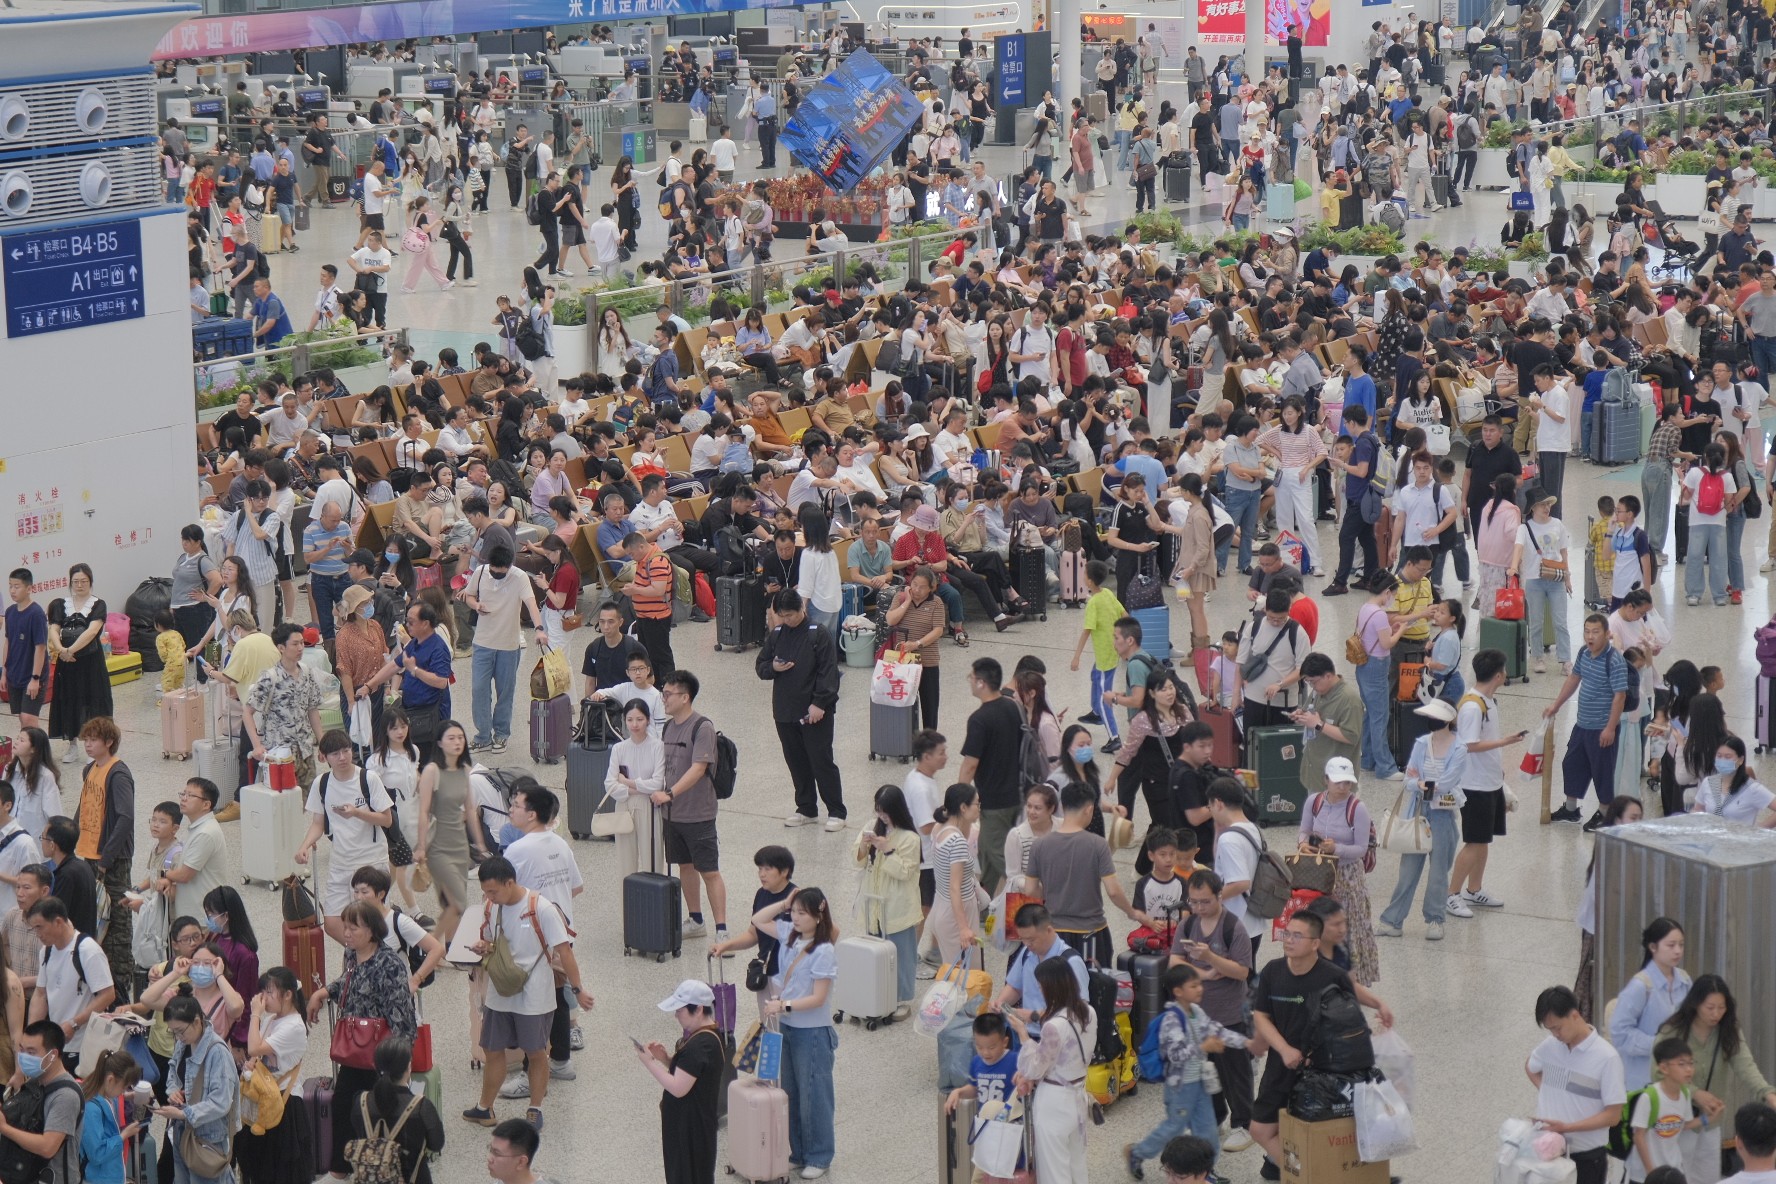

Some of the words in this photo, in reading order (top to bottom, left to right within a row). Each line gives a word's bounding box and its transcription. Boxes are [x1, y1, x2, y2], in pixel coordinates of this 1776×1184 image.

[1007, 41, 1017, 57] B1
[1002, 61, 1023, 74] 检票口
[43, 239, 68, 252] 检票口
[71, 270, 91, 292] A1
[93, 268, 109, 281] 出口
[88, 303, 94, 319] 1
[95, 301, 114, 311] 检票口
[1416, 416, 1433, 424] Paris
[18, 487, 59, 505] 消火栓
[114, 527, 152, 546] 检修门
[21, 551, 40, 566] 火警
[45, 548, 62, 560] 119
[886, 679, 908, 700] 喜
[977, 1079, 1005, 1104] 56
